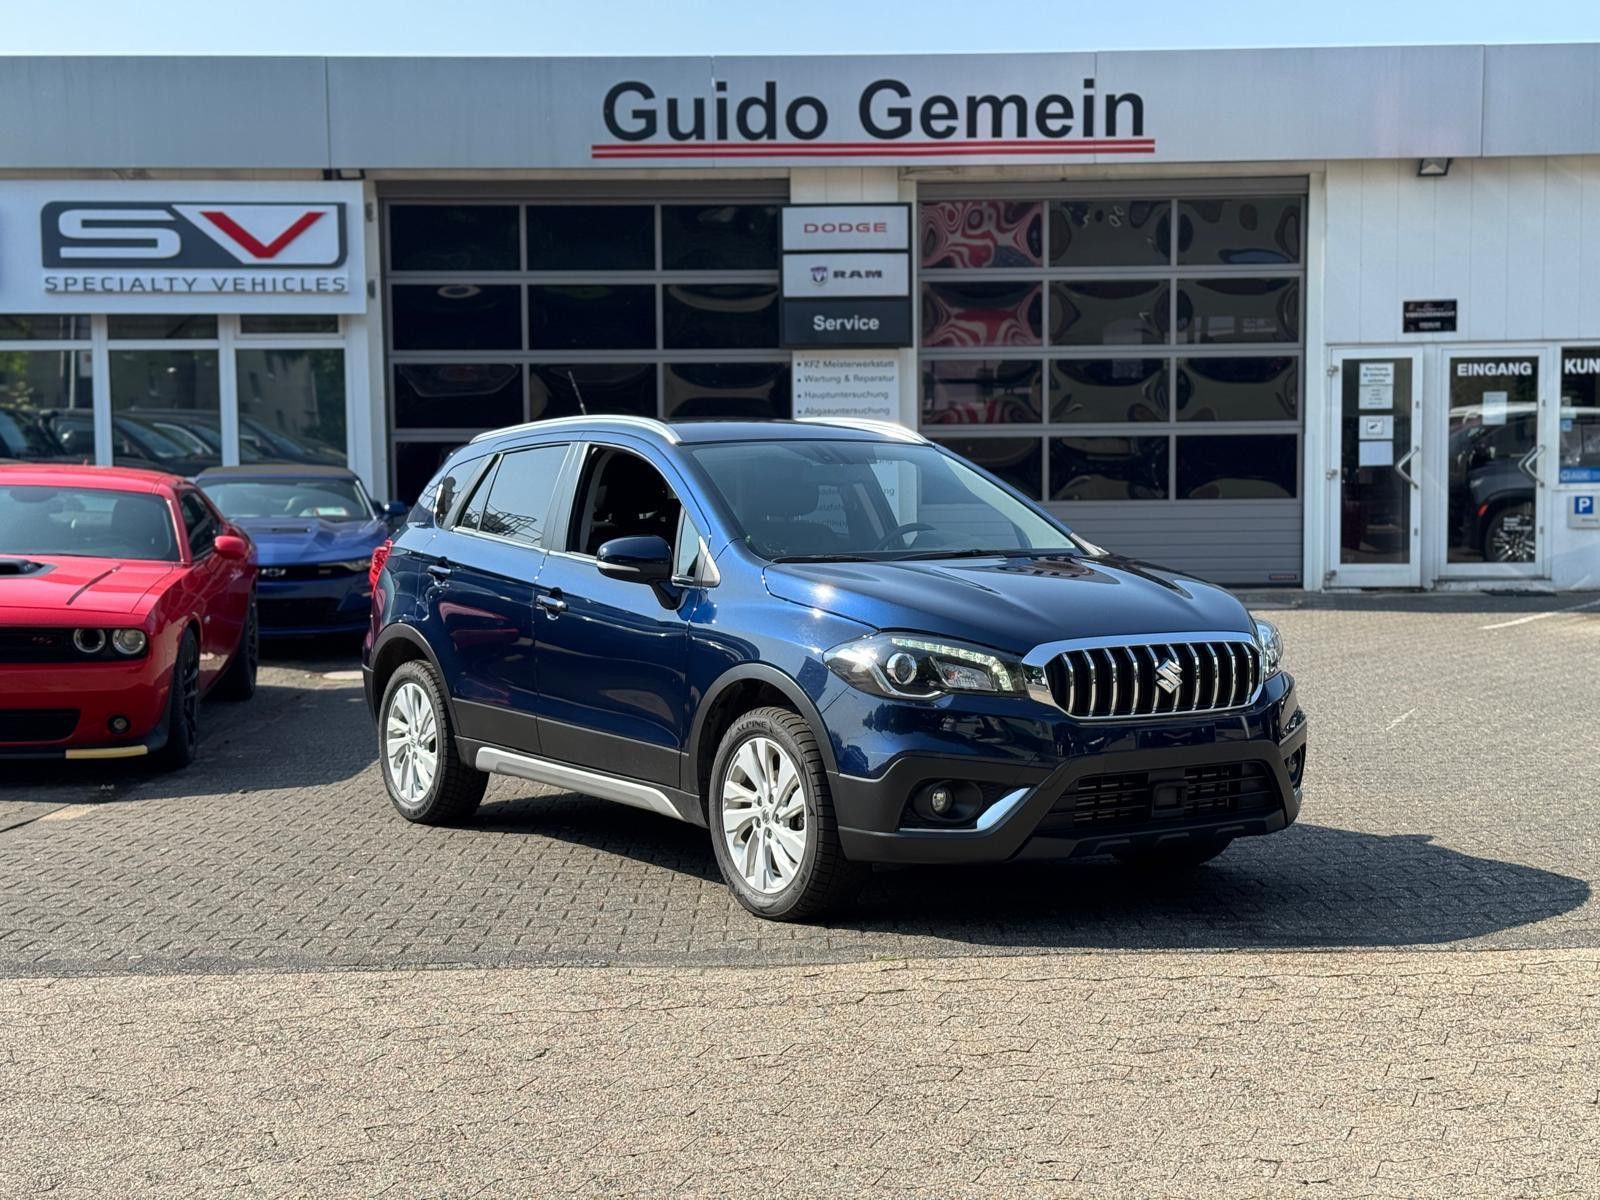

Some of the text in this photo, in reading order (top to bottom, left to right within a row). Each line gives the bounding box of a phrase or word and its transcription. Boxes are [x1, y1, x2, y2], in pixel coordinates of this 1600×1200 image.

[603, 78, 1144, 142] Guido Gemein
[803, 223, 887, 234] DODGE
[833, 269, 882, 279] RAM
[44, 276, 347, 292] SPECIALTY VEHICLES
[813, 314, 880, 331] Service
[803, 360, 820, 368] KFZ
[1457, 362, 1533, 376] EINGANG
